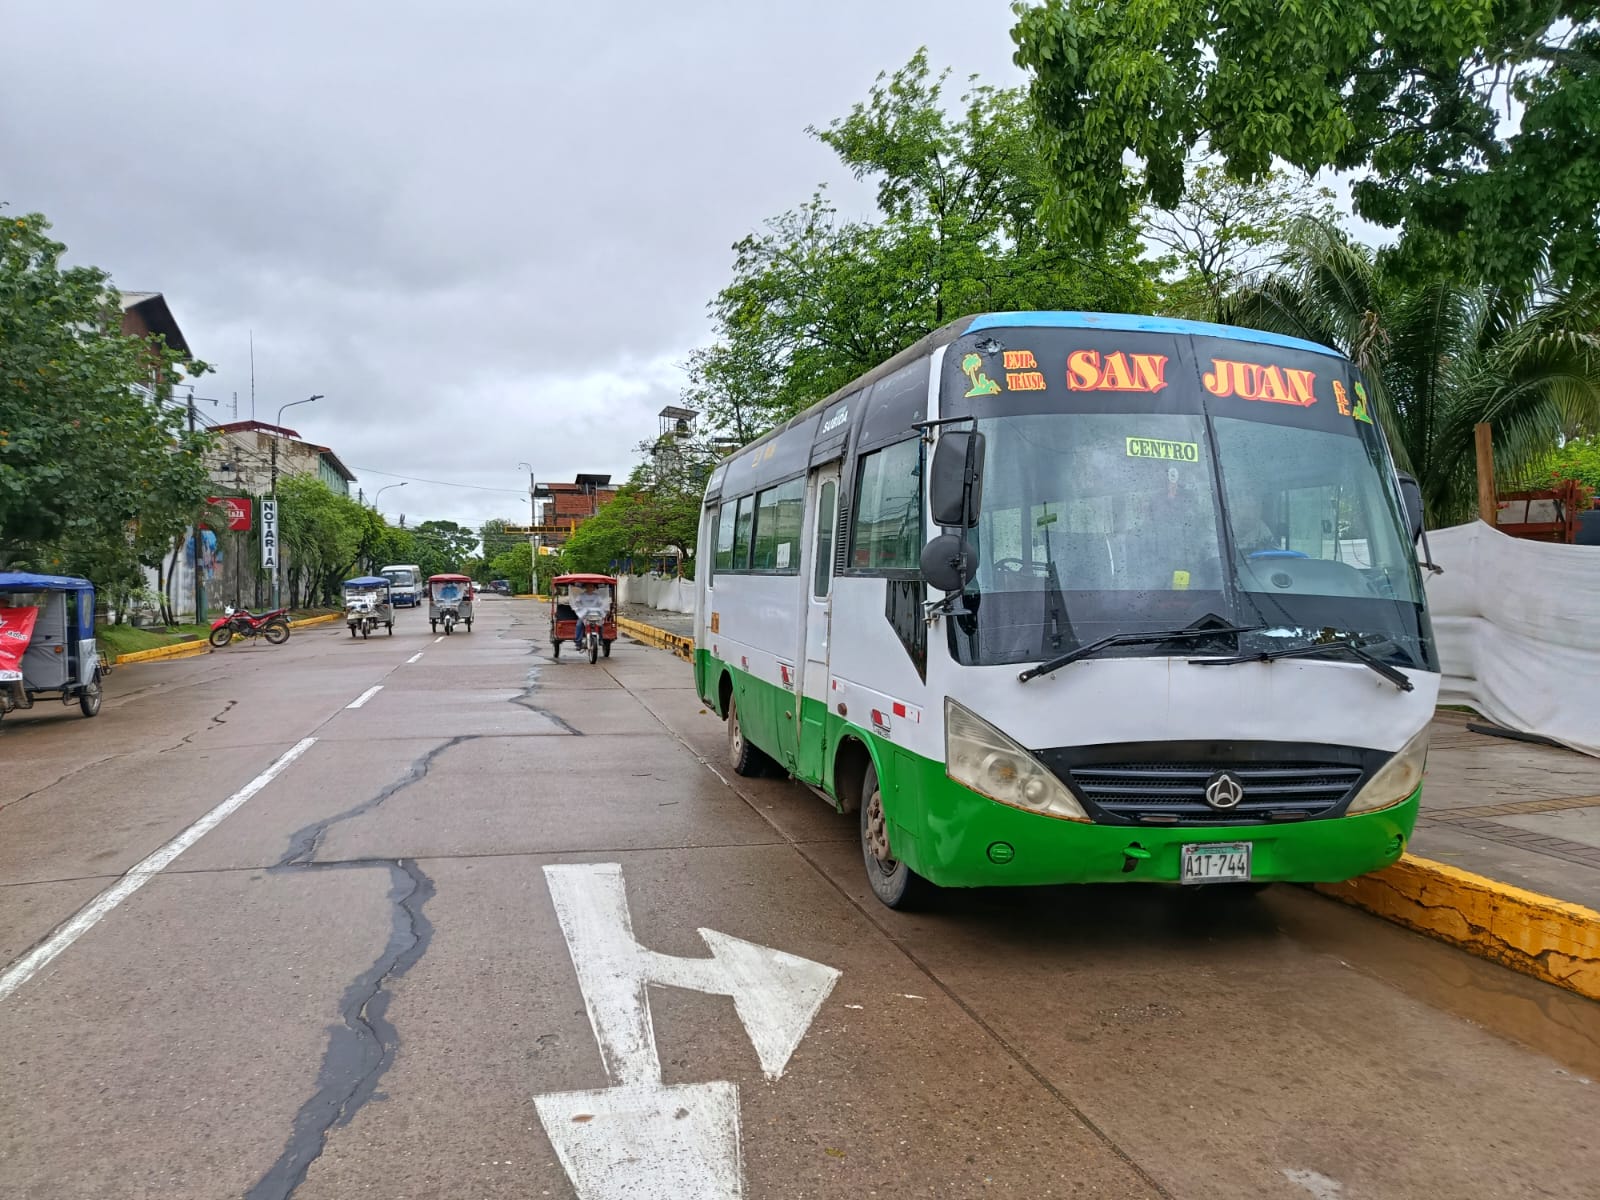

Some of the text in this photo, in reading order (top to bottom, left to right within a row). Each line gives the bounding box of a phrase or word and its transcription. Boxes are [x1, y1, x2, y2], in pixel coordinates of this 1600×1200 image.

[1003, 350, 1037, 369] EMP.
[1006, 372, 1047, 391] TRANSP.
[1066, 350, 1317, 407] SAN JUAN
[1129, 439, 1196, 461] CENTRO
[263, 502, 274, 566] NOTARIA
[1185, 854, 1246, 876] A1T-744
